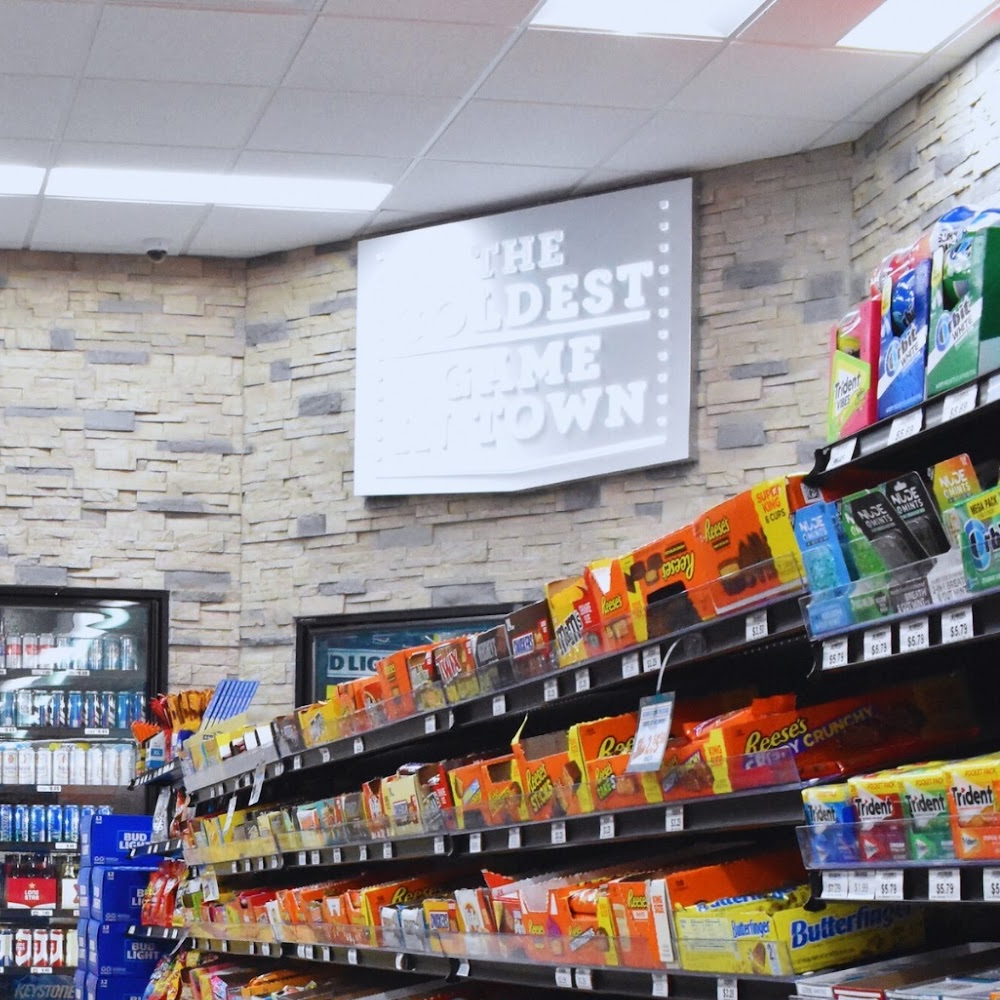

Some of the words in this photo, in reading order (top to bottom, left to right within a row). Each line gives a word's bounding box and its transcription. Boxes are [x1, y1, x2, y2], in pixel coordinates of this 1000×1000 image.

[473, 230, 563, 279] THE
[936, 299, 971, 351] Orbit
[952, 316, 975, 341] WHITE
[885, 324, 917, 377] Orbit
[835, 374, 861, 399] Trident
[472, 380, 648, 447] TOWN
[755, 484, 782, 504] SUPER
[949, 481, 971, 497] MINTS
[762, 499, 781, 514] KING
[902, 499, 924, 512] MINTS
[970, 501, 984, 515] MEGA
[984, 495, 998, 507] PACK
[770, 509, 786, 523] CUPS
[870, 513, 893, 527] MINTS
[704, 517, 730, 542] Reese's
[950, 623, 967, 637] $5.79
[908, 634, 924, 647] $5.79
[436, 649, 462, 684] TWIX
[745, 719, 808, 753] Reese's
[803, 706, 873, 747] CRUNCHY
[965, 770, 982, 778] POCKET
[983, 767, 996, 776] PACK
[905, 795, 945, 814] Trident
[951, 786, 993, 806] Trident
[808, 805, 836, 822] Trident
[855, 798, 892, 817] Trident
[124, 832, 147, 841] BUD
[881, 883, 897, 895] $5.79
[936, 883, 954, 895] $5.79
[731, 919, 770, 939] Butterfinger
[791, 903, 911, 949] Butterfinger
[127, 950, 160, 960] LIGHT
[14, 983, 75, 1000] KEYSTONE
